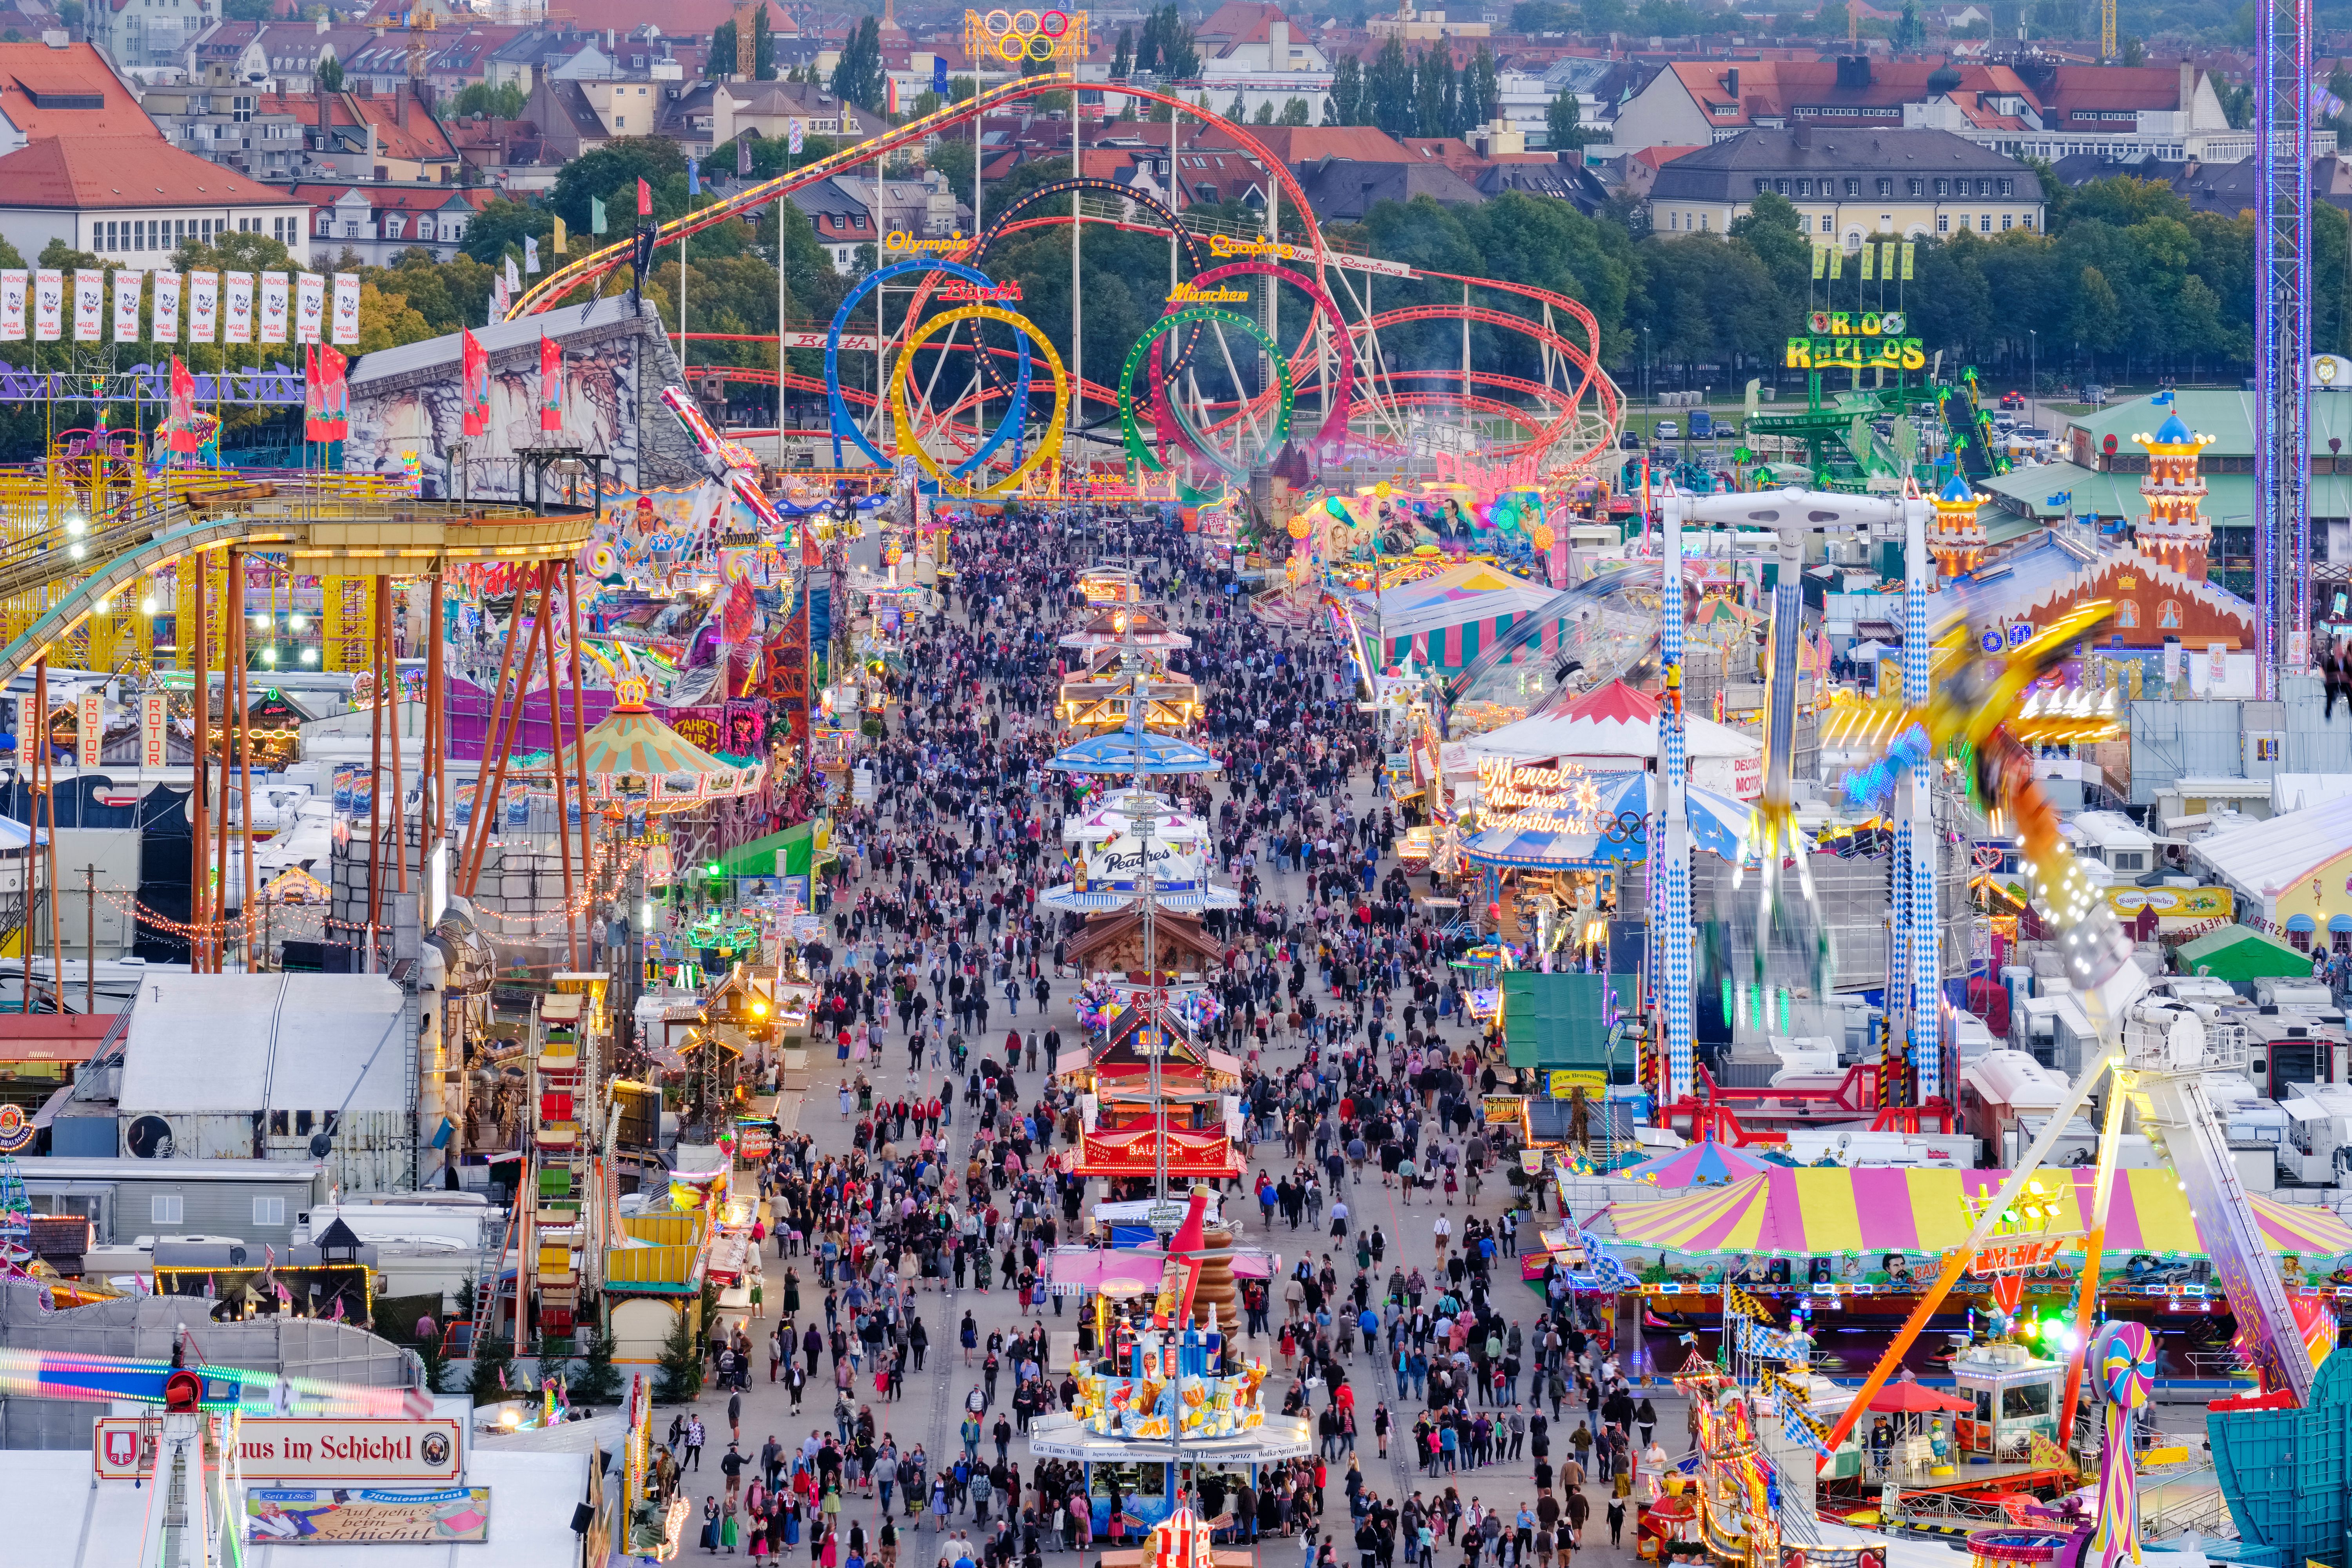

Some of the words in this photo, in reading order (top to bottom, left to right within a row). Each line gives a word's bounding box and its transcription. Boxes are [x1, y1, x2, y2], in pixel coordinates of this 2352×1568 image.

[886, 230, 969, 253] Olympia
[1209, 234, 1293, 260] Looping
[1340, 258, 1403, 276] Looping
[78, 275, 102, 283] MÜNCH
[117, 276, 141, 284] MÜNCH
[157, 276, 180, 286] MÜNCH
[193, 277, 217, 286] MÜNCH
[229, 277, 252, 286] MÜNCH
[264, 277, 287, 285] MÜNCH
[301, 278, 324, 288] MÜNCH
[337, 278, 359, 288] MÜNCH
[938, 280, 1023, 300] Barth
[1165, 282, 1249, 302] München
[1832, 311, 1881, 334] RIO
[793, 334, 870, 348] Bath
[1787, 338, 1925, 369] RAPIDOS
[1549, 463, 1598, 473] WESTEN
[1436, 451, 1538, 502] Playball
[85, 699, 98, 765] ROTOR
[148, 699, 161, 765] ROTOR
[673, 719, 720, 740] FAHRT
[1486, 787, 1568, 809] Münchner
[1475, 807, 1589, 835] Zugspitzbahn
[1105, 849, 1170, 874] Peahes
[1571, 1072, 1607, 1083] Bratwurst
[1484, 1103, 1521, 1116] Bratwurst
[742, 1132, 771, 1142] Schoko-
[741, 1141, 773, 1151] Früchte
[1088, 1143, 1111, 1156] WIESN
[1199, 1145, 1223, 1158] WODKA
[1087, 1149, 1109, 1161] CAIPI
[1202, 1150, 1225, 1162] BULL
[284, 1437, 313, 1463] im
[321, 1436, 413, 1463] Schichtl
[287, 1492, 314, 1501] 1869
[336, 1507, 373, 1518] Auf
[342, 1516, 386, 1527] beim
[316, 1525, 434, 1542] Schichtl
